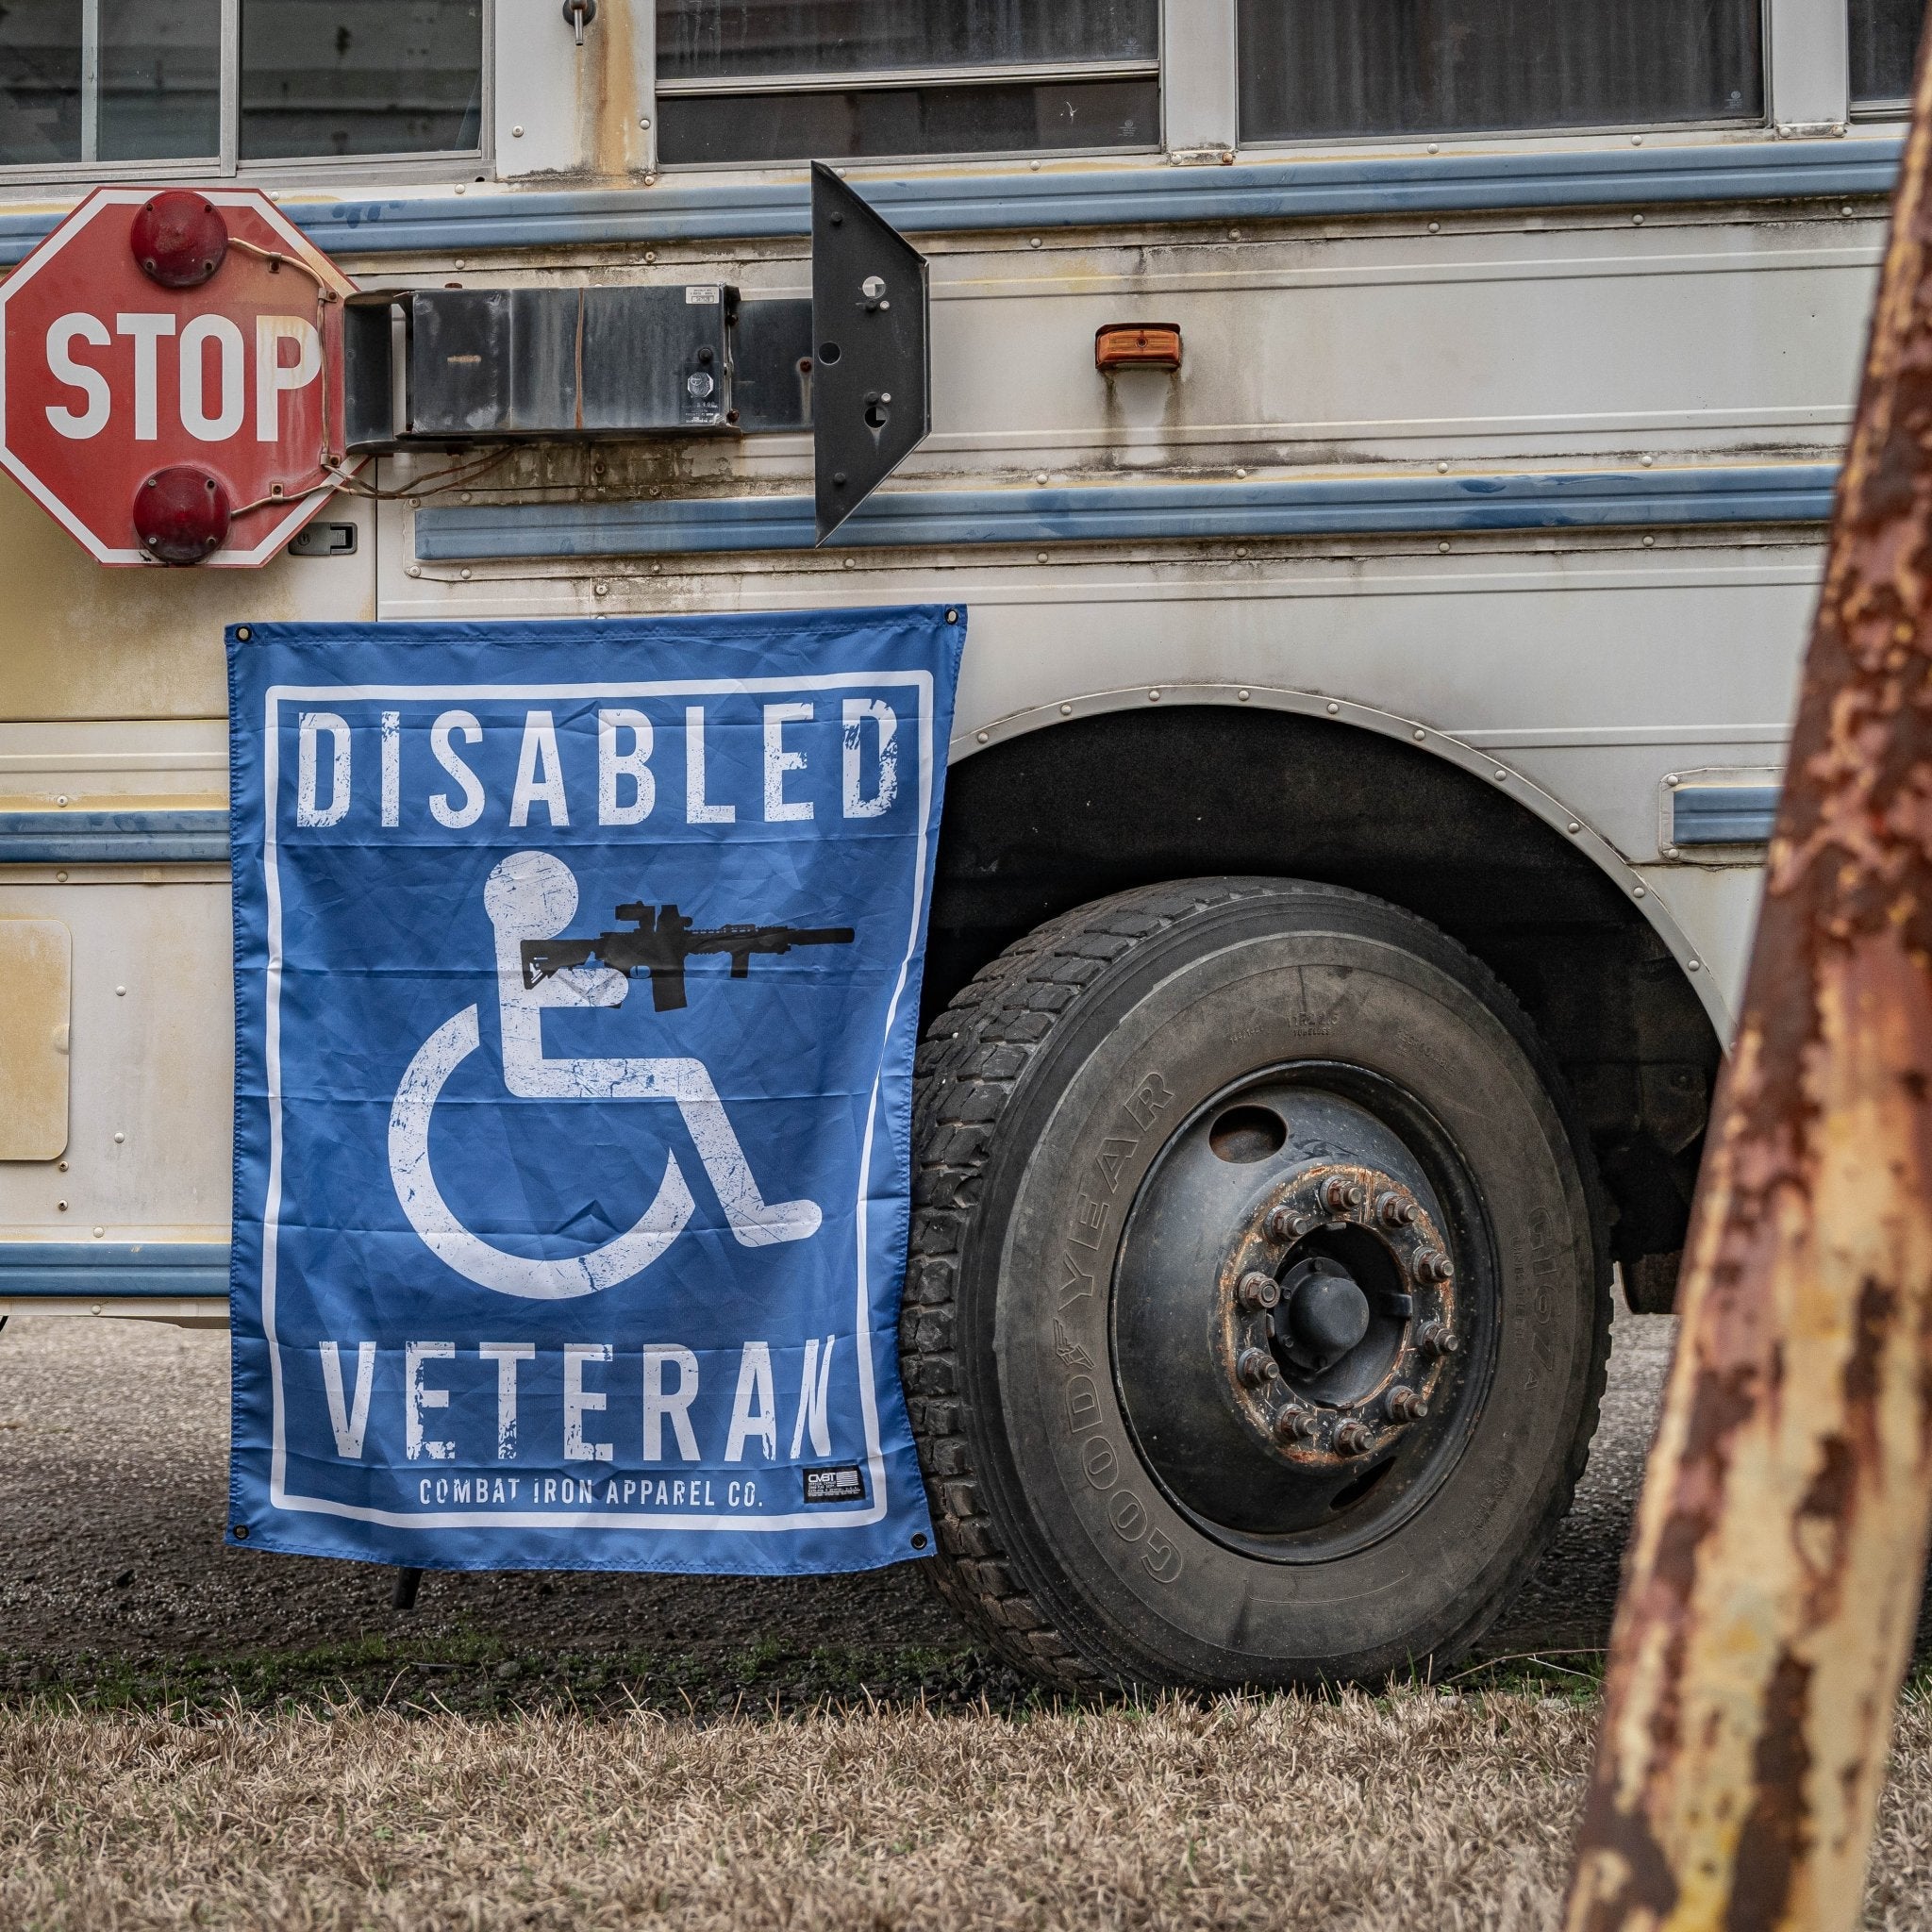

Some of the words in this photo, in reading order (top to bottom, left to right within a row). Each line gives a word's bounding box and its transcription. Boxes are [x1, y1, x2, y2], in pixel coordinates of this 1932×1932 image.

[45, 312, 322, 442] STOP
[296, 698, 899, 829] DISABLED
[319, 1335, 836, 1461] VETERAN
[419, 1478, 521, 1505] COMBAT
[533, 1478, 593, 1505] IRON
[606, 1479, 721, 1507] APPAREL
[728, 1481, 764, 1508] CO.
